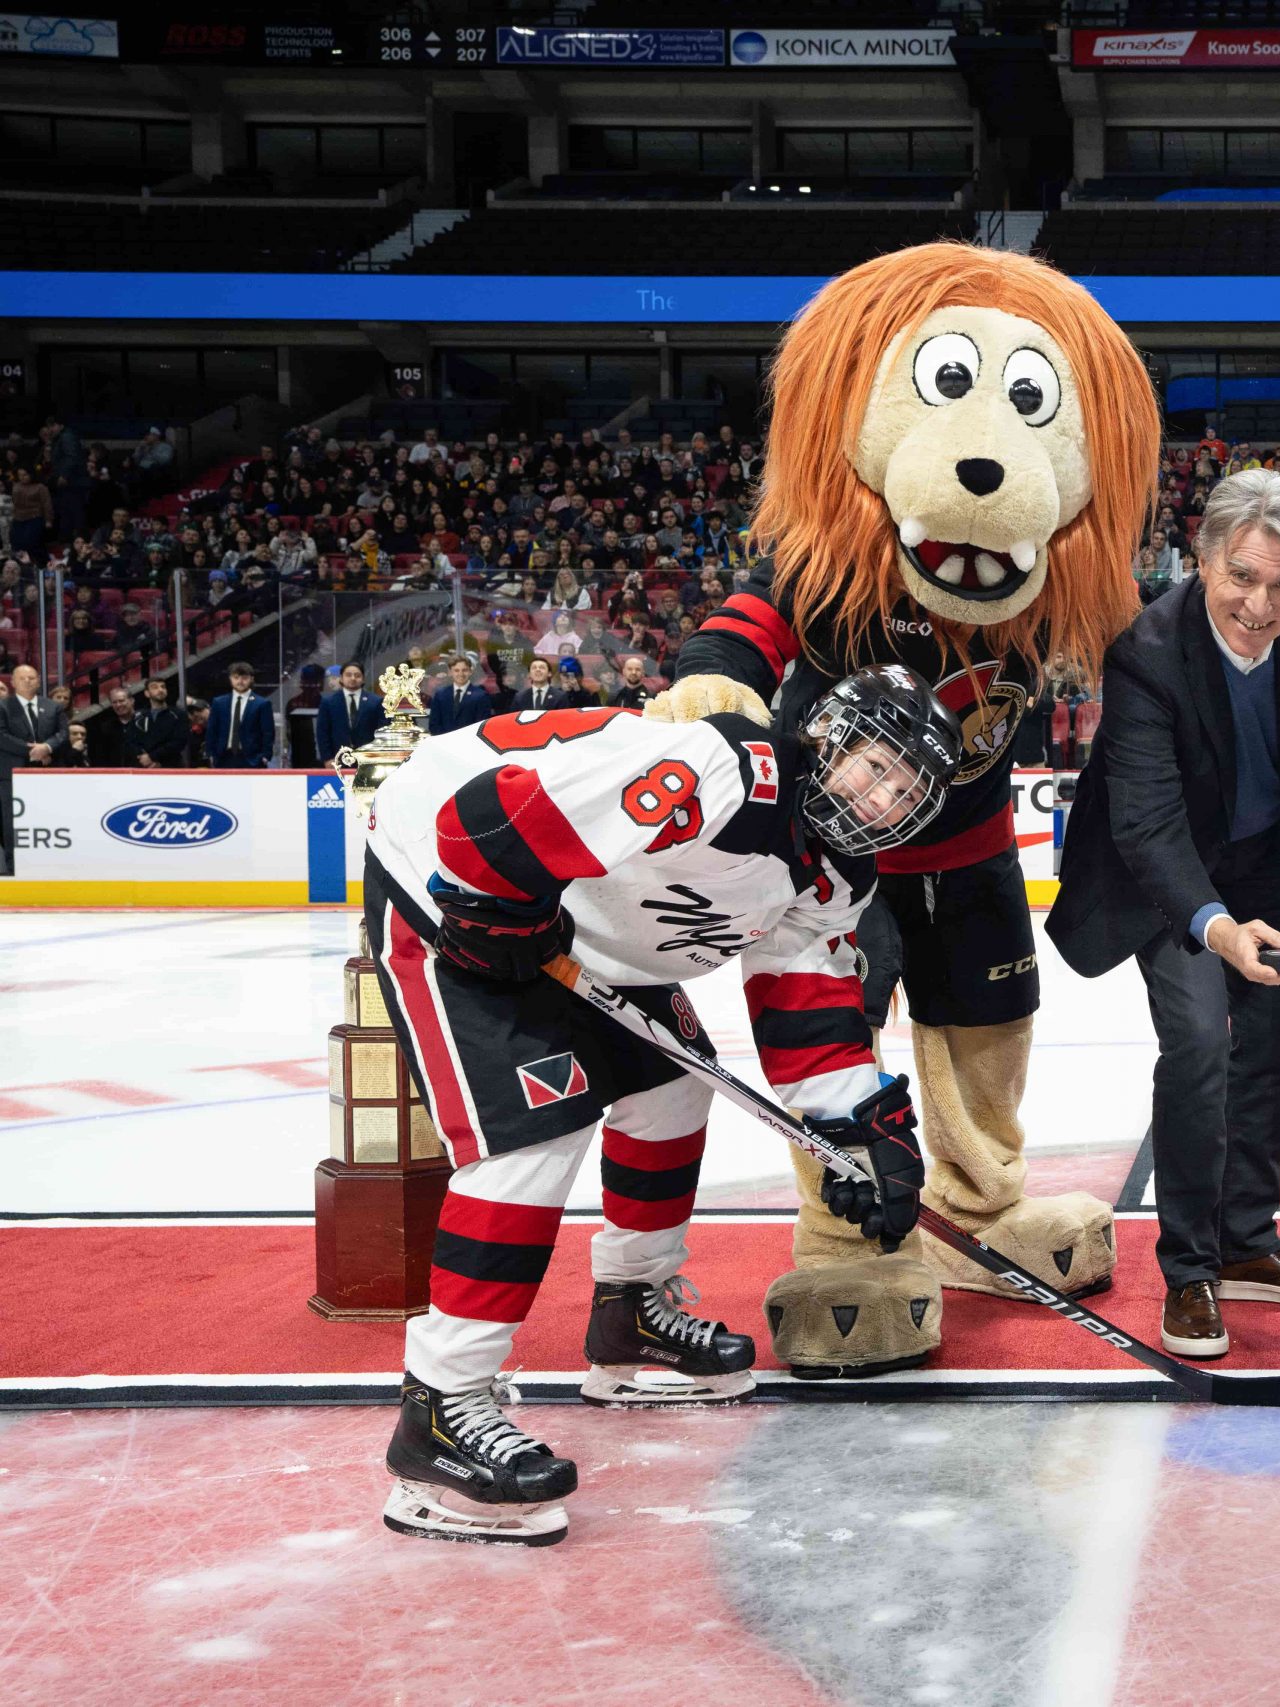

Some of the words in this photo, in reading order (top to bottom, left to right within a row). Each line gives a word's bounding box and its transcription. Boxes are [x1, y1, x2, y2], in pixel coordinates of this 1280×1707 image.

[163, 24, 247, 47] ROSS
[264, 26, 333, 37] PRODUCTION
[380, 27, 412, 42] 306
[455, 28, 486, 42] 307
[265, 37, 335, 47] TECHNOLOGY
[500, 33, 632, 58] ALIGNED
[776, 39, 859, 56] KONICA
[1208, 41, 1250, 55] Know
[265, 48, 312, 58] EXPERTS
[380, 47, 412, 61] 206
[456, 48, 486, 62] 207
[0, 364, 22, 377] 04
[395, 368, 421, 380] 105
[922, 733, 954, 766] CCM
[307, 799, 345, 808] adidas
[128, 804, 211, 840] Ford
[13, 828, 72, 849] ERS
[987, 954, 1036, 981] CC
[715, 1066, 733, 1080] FLEX
[757, 1107, 805, 1149] VAPOR
[925, 1207, 968, 1237] VAPOR
[1000, 1271, 1133, 1350] BAUER
